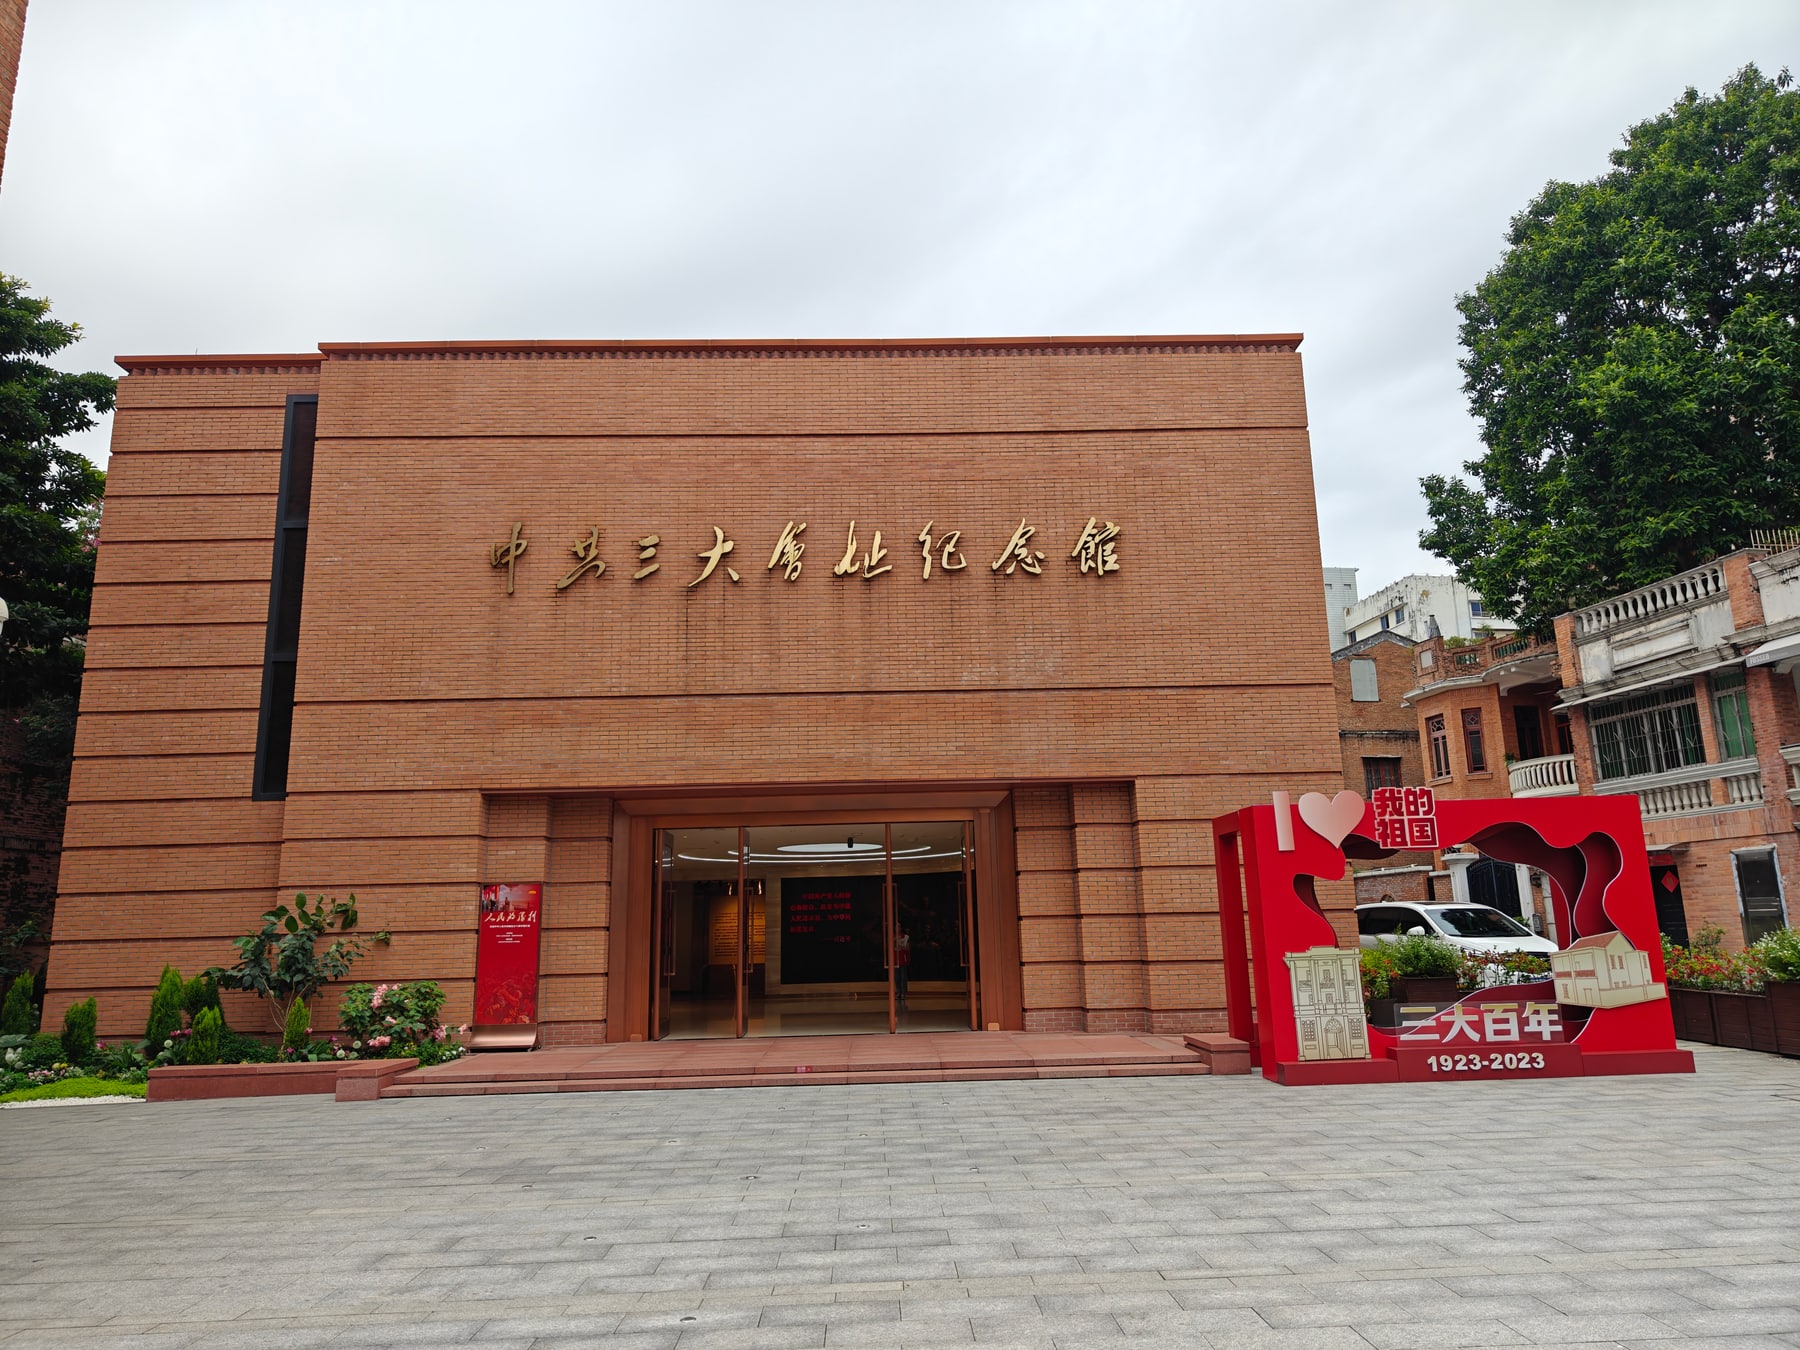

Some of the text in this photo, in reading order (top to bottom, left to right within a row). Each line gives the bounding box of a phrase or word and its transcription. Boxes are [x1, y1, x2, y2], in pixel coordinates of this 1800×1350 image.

[1372, 787, 1436, 818] 我的
[1272, 790, 1295, 851] I
[1374, 816, 1439, 849] 祖国
[1400, 1002, 1563, 1043] 三大百年
[1427, 1052, 1545, 1072] 1923-2023
